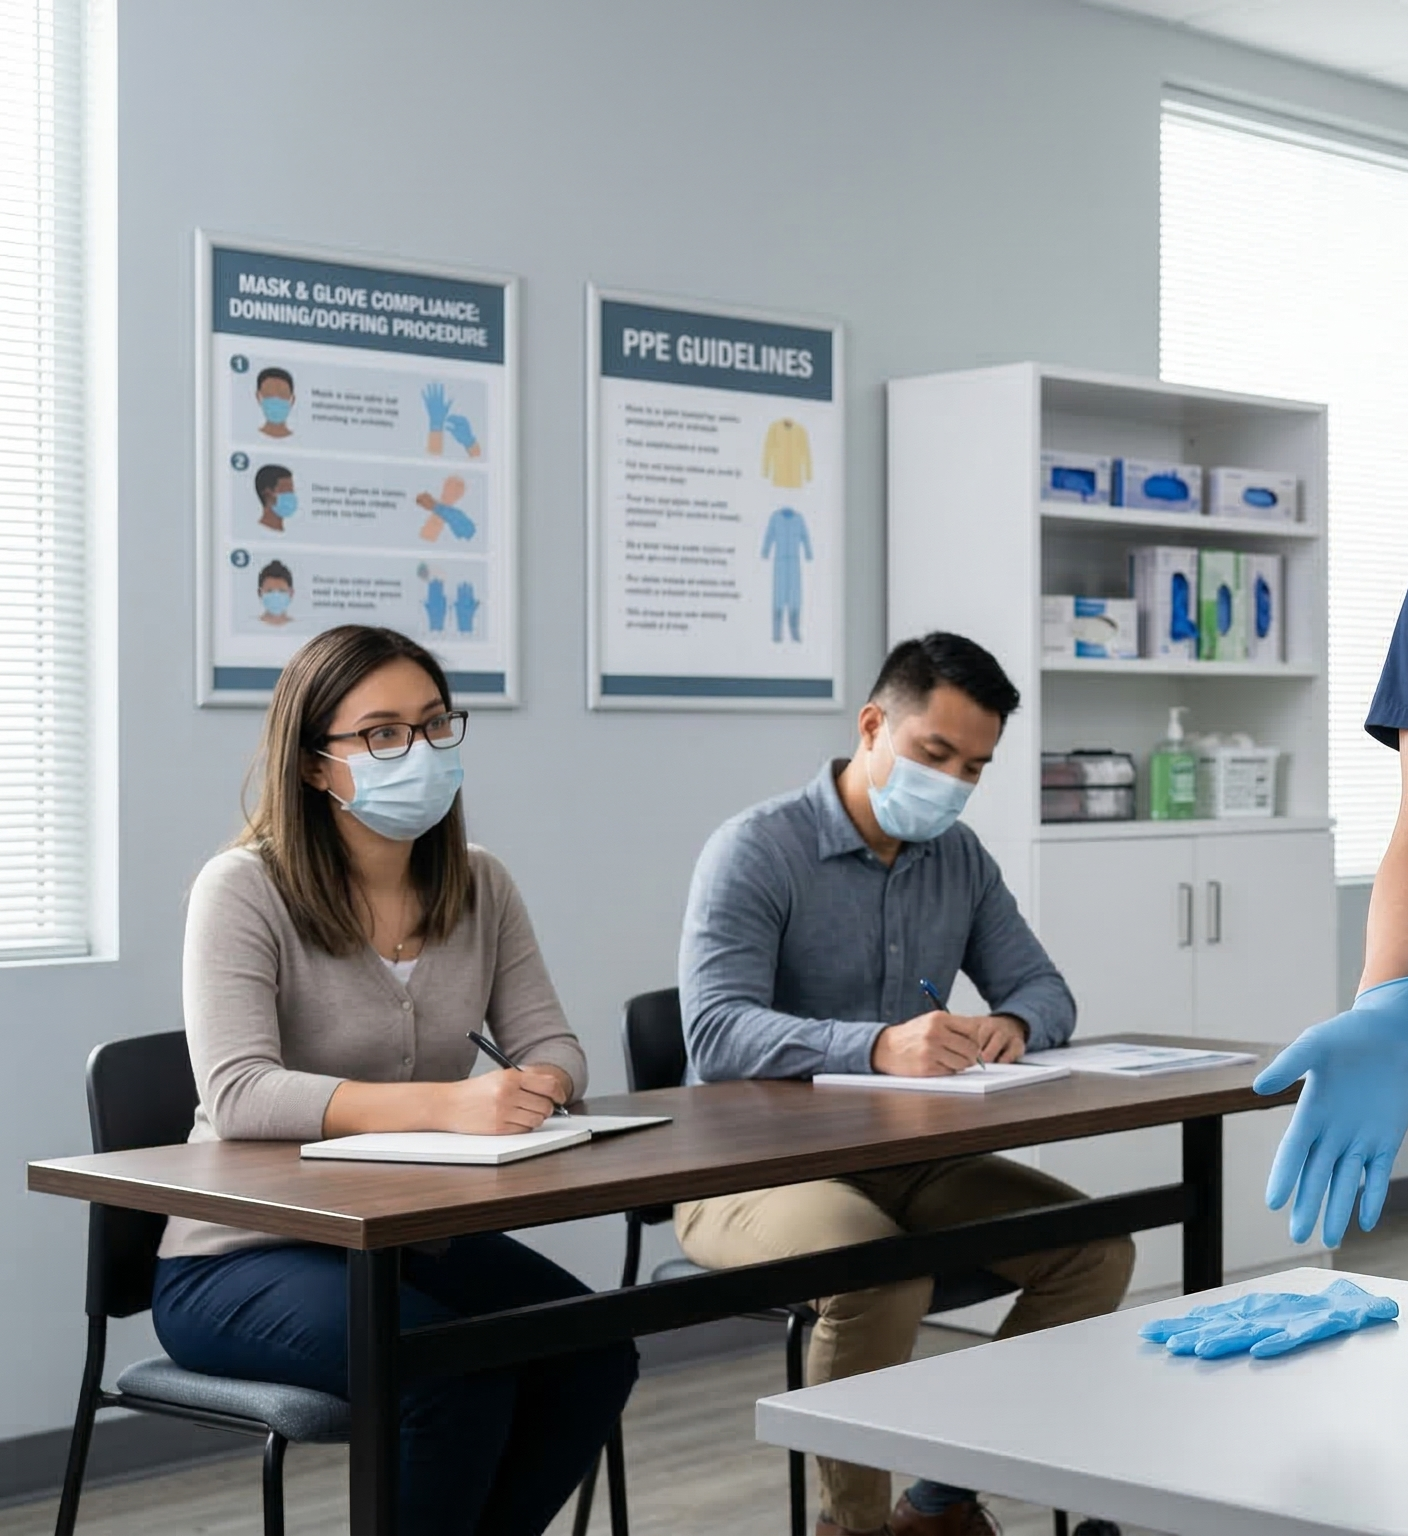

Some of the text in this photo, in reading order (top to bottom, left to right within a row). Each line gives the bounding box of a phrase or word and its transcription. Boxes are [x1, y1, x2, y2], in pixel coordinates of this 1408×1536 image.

[238, 273, 480, 322] MASK & GLOVE COMPLIANCE:
[230, 298, 488, 347] DONNING/DOFFING PROCEDURE
[623, 327, 813, 378] PPE GUIDELINES
